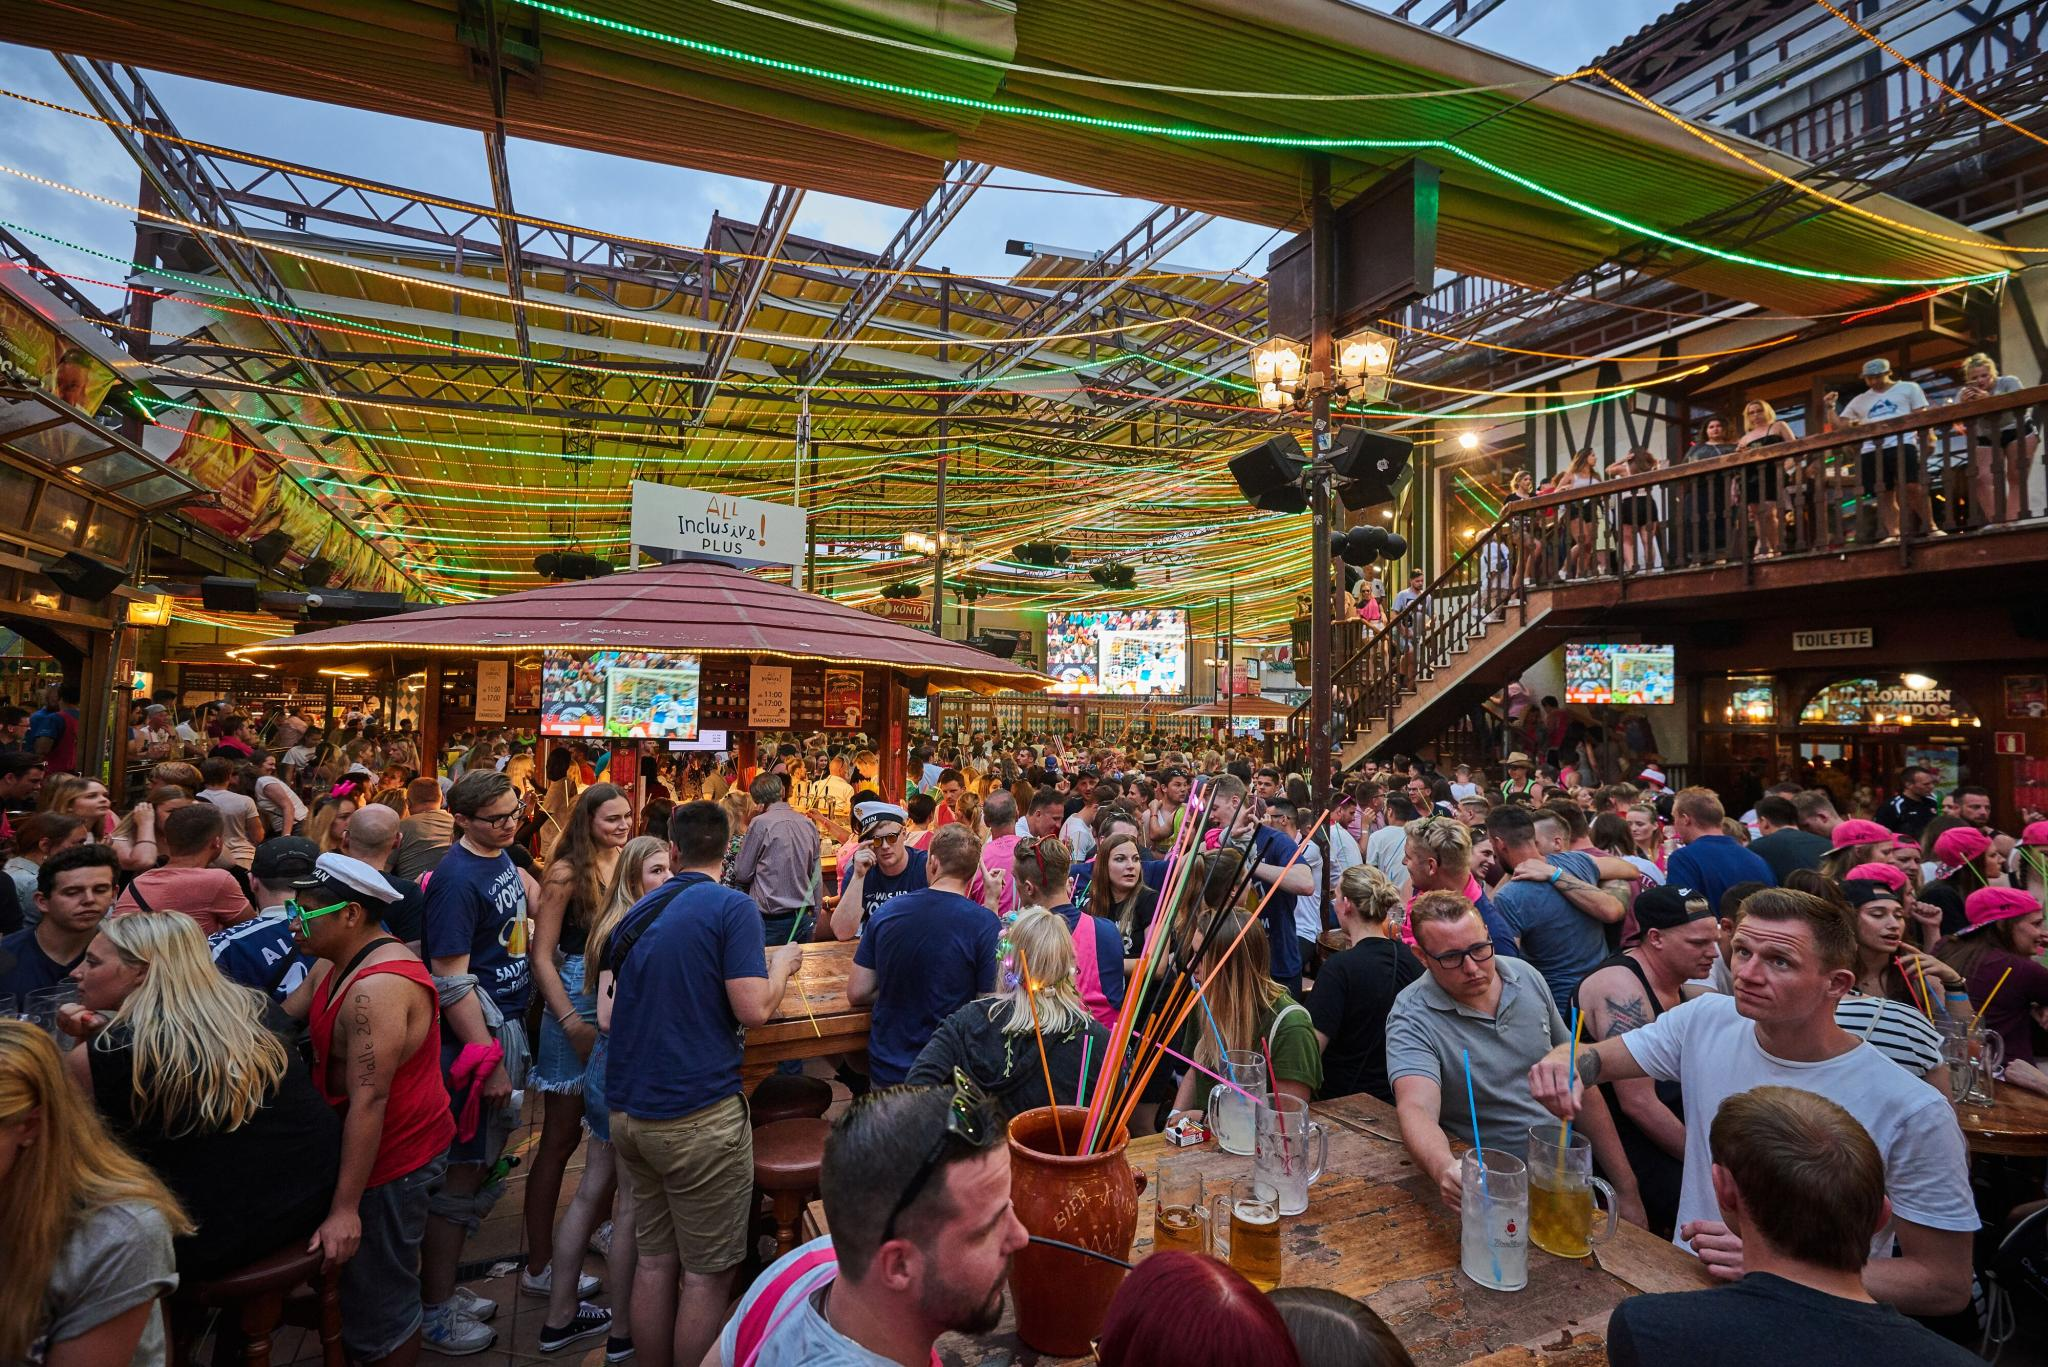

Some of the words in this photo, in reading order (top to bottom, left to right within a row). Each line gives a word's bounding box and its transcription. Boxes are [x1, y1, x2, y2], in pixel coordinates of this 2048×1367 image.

[706, 496, 738, 520] ALL
[702, 538, 743, 554] PLUS
[893, 604, 923, 614] KÖNIG
[1797, 631, 1869, 647] TOILETTE
[495, 868, 514, 885] WAS
[355, 994, 371, 1036] 2019
[358, 1042, 376, 1087] Malle
